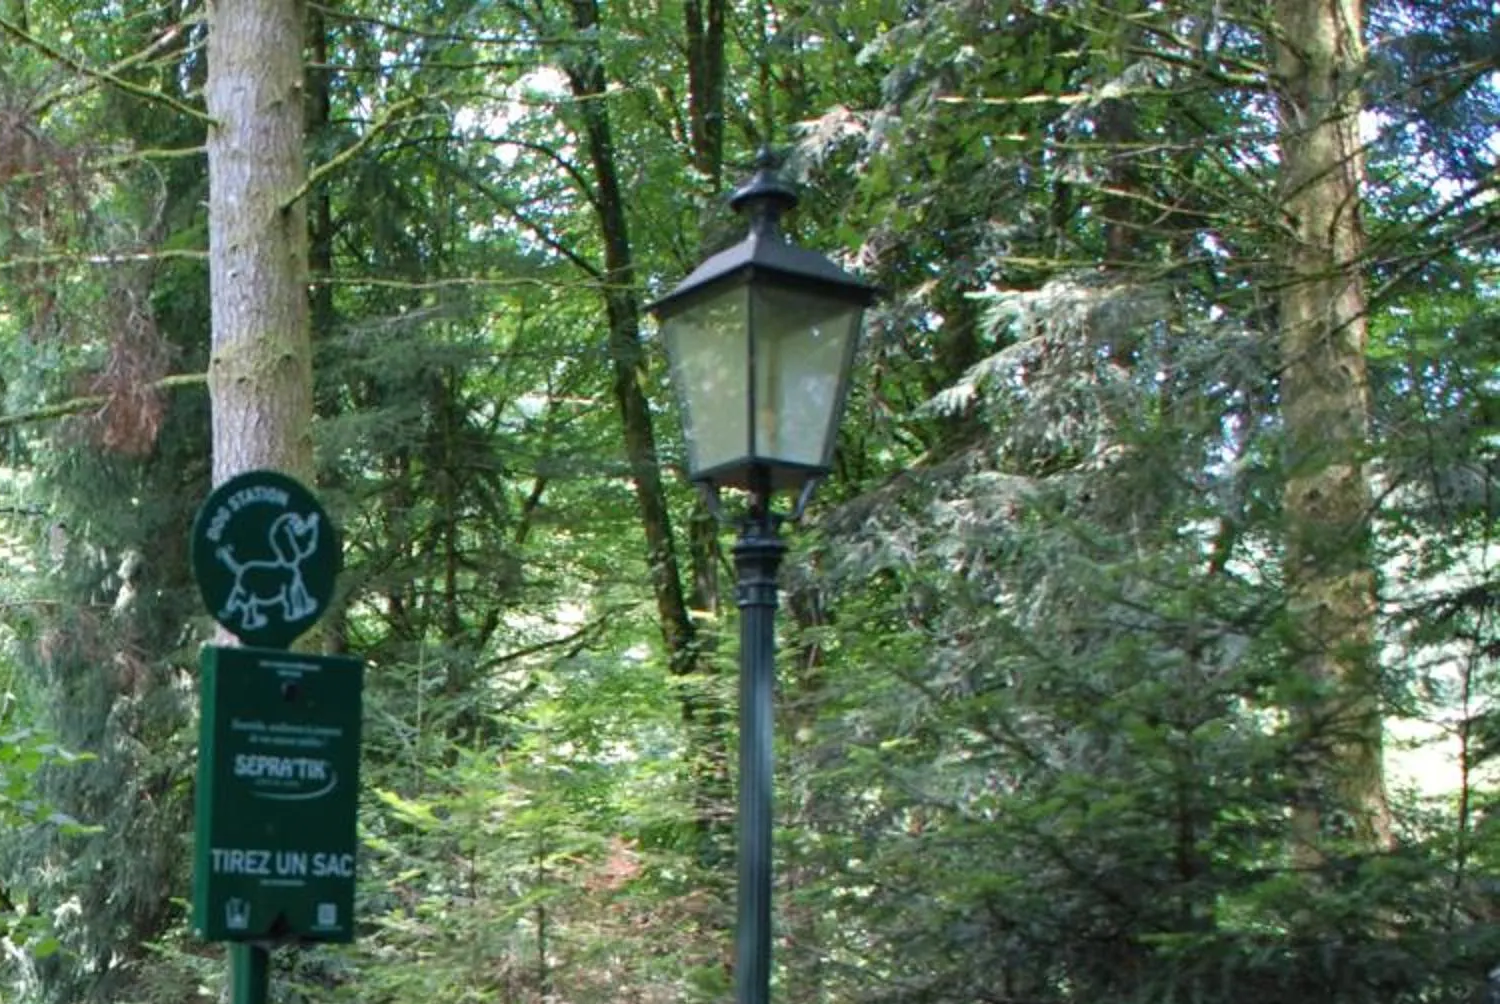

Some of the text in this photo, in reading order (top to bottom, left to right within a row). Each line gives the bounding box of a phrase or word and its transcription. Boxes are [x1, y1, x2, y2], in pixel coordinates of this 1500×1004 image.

[227, 486, 290, 512] STATION
[211, 848, 354, 877] TIREZ UN SAC
